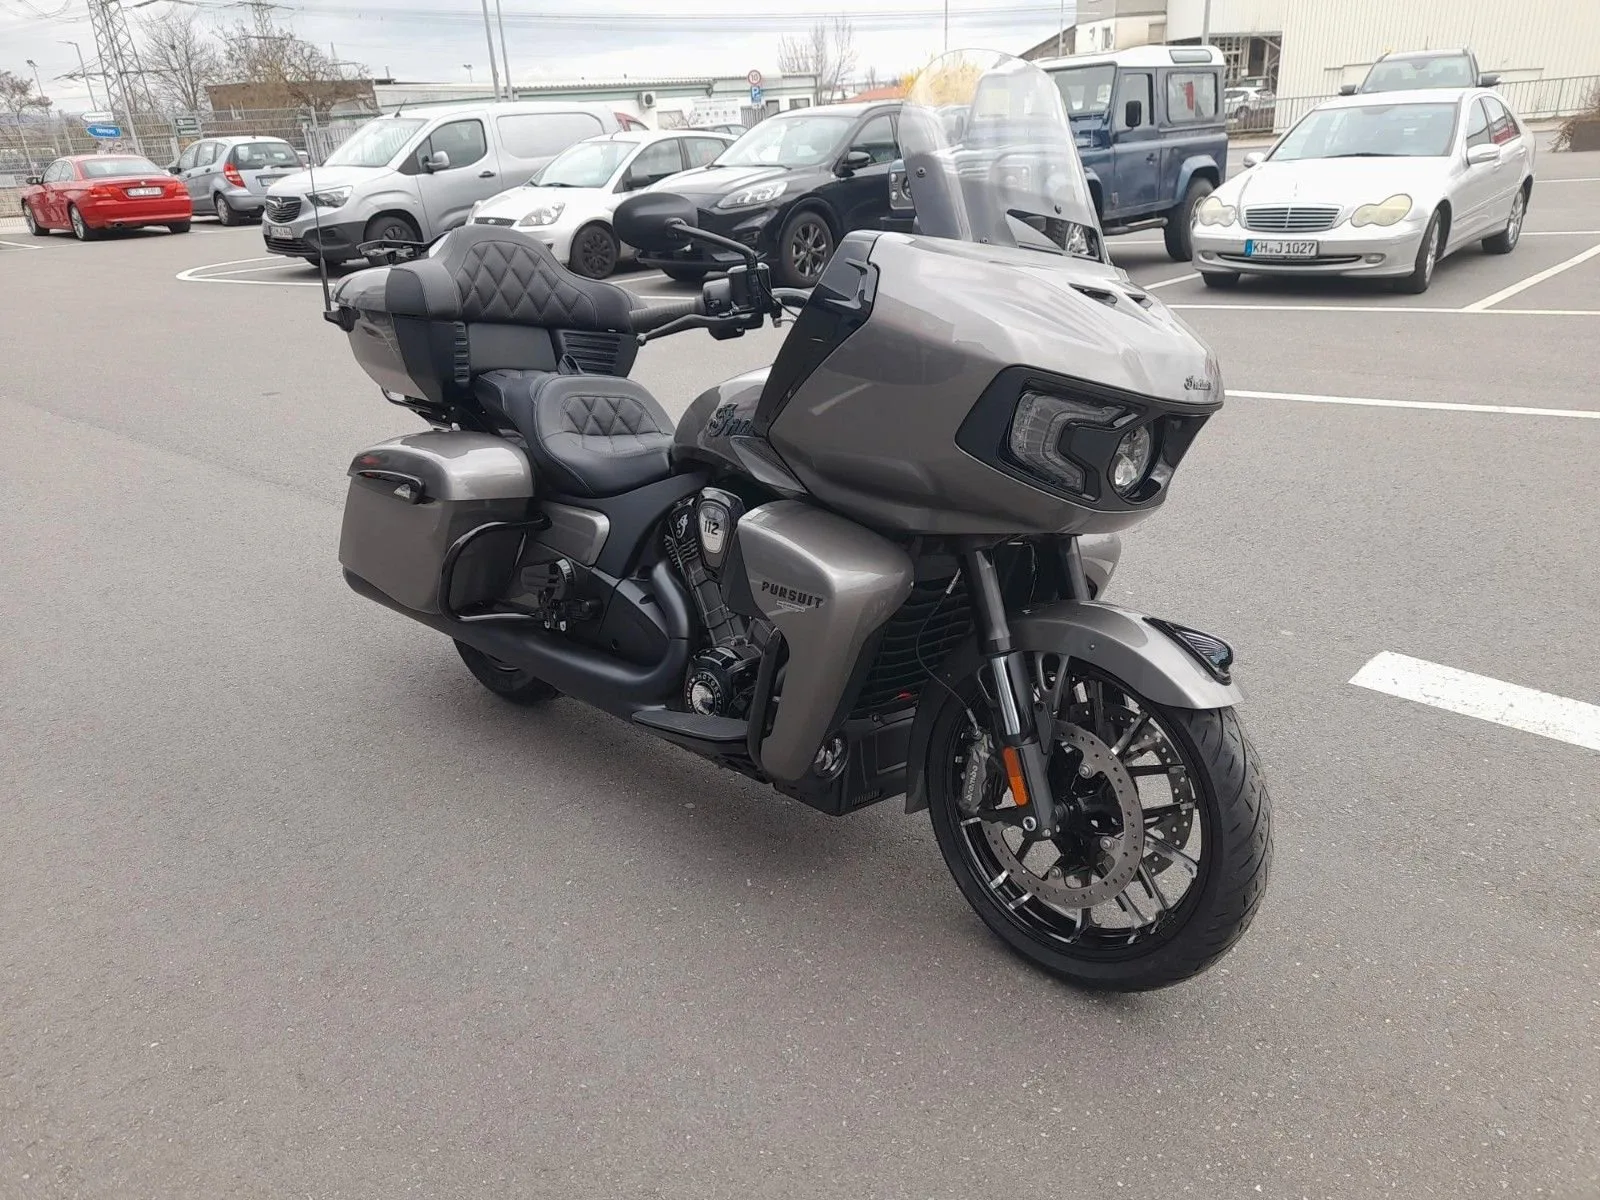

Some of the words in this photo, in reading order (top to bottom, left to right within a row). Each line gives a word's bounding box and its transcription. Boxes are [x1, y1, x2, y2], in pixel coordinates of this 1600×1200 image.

[1253, 241, 1268, 253] KH
[704, 520, 720, 535] 112
[761, 581, 824, 609] PURSUIT
